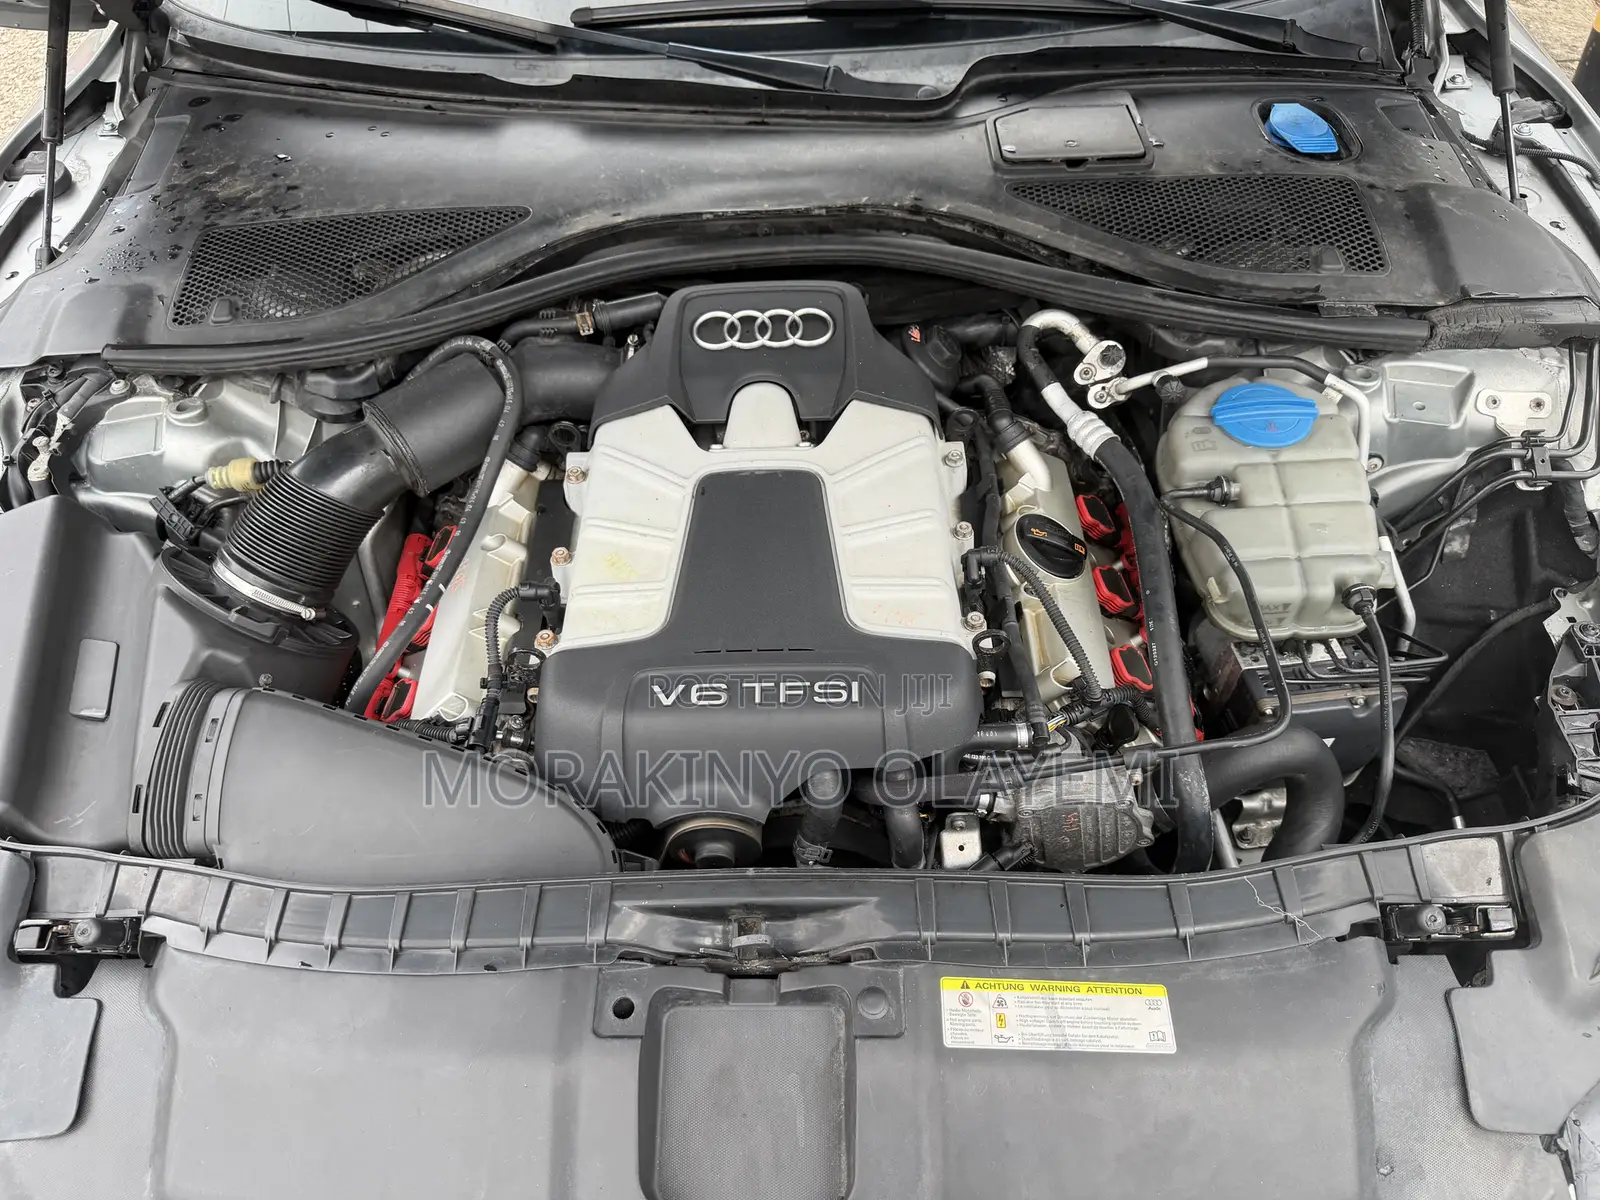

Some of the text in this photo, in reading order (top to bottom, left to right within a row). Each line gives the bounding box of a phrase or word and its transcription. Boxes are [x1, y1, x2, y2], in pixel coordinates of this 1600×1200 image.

[650, 680, 859, 706] V6 TFSI
[974, 982, 1143, 995] ACHTUNG WARNING ATTENTION
